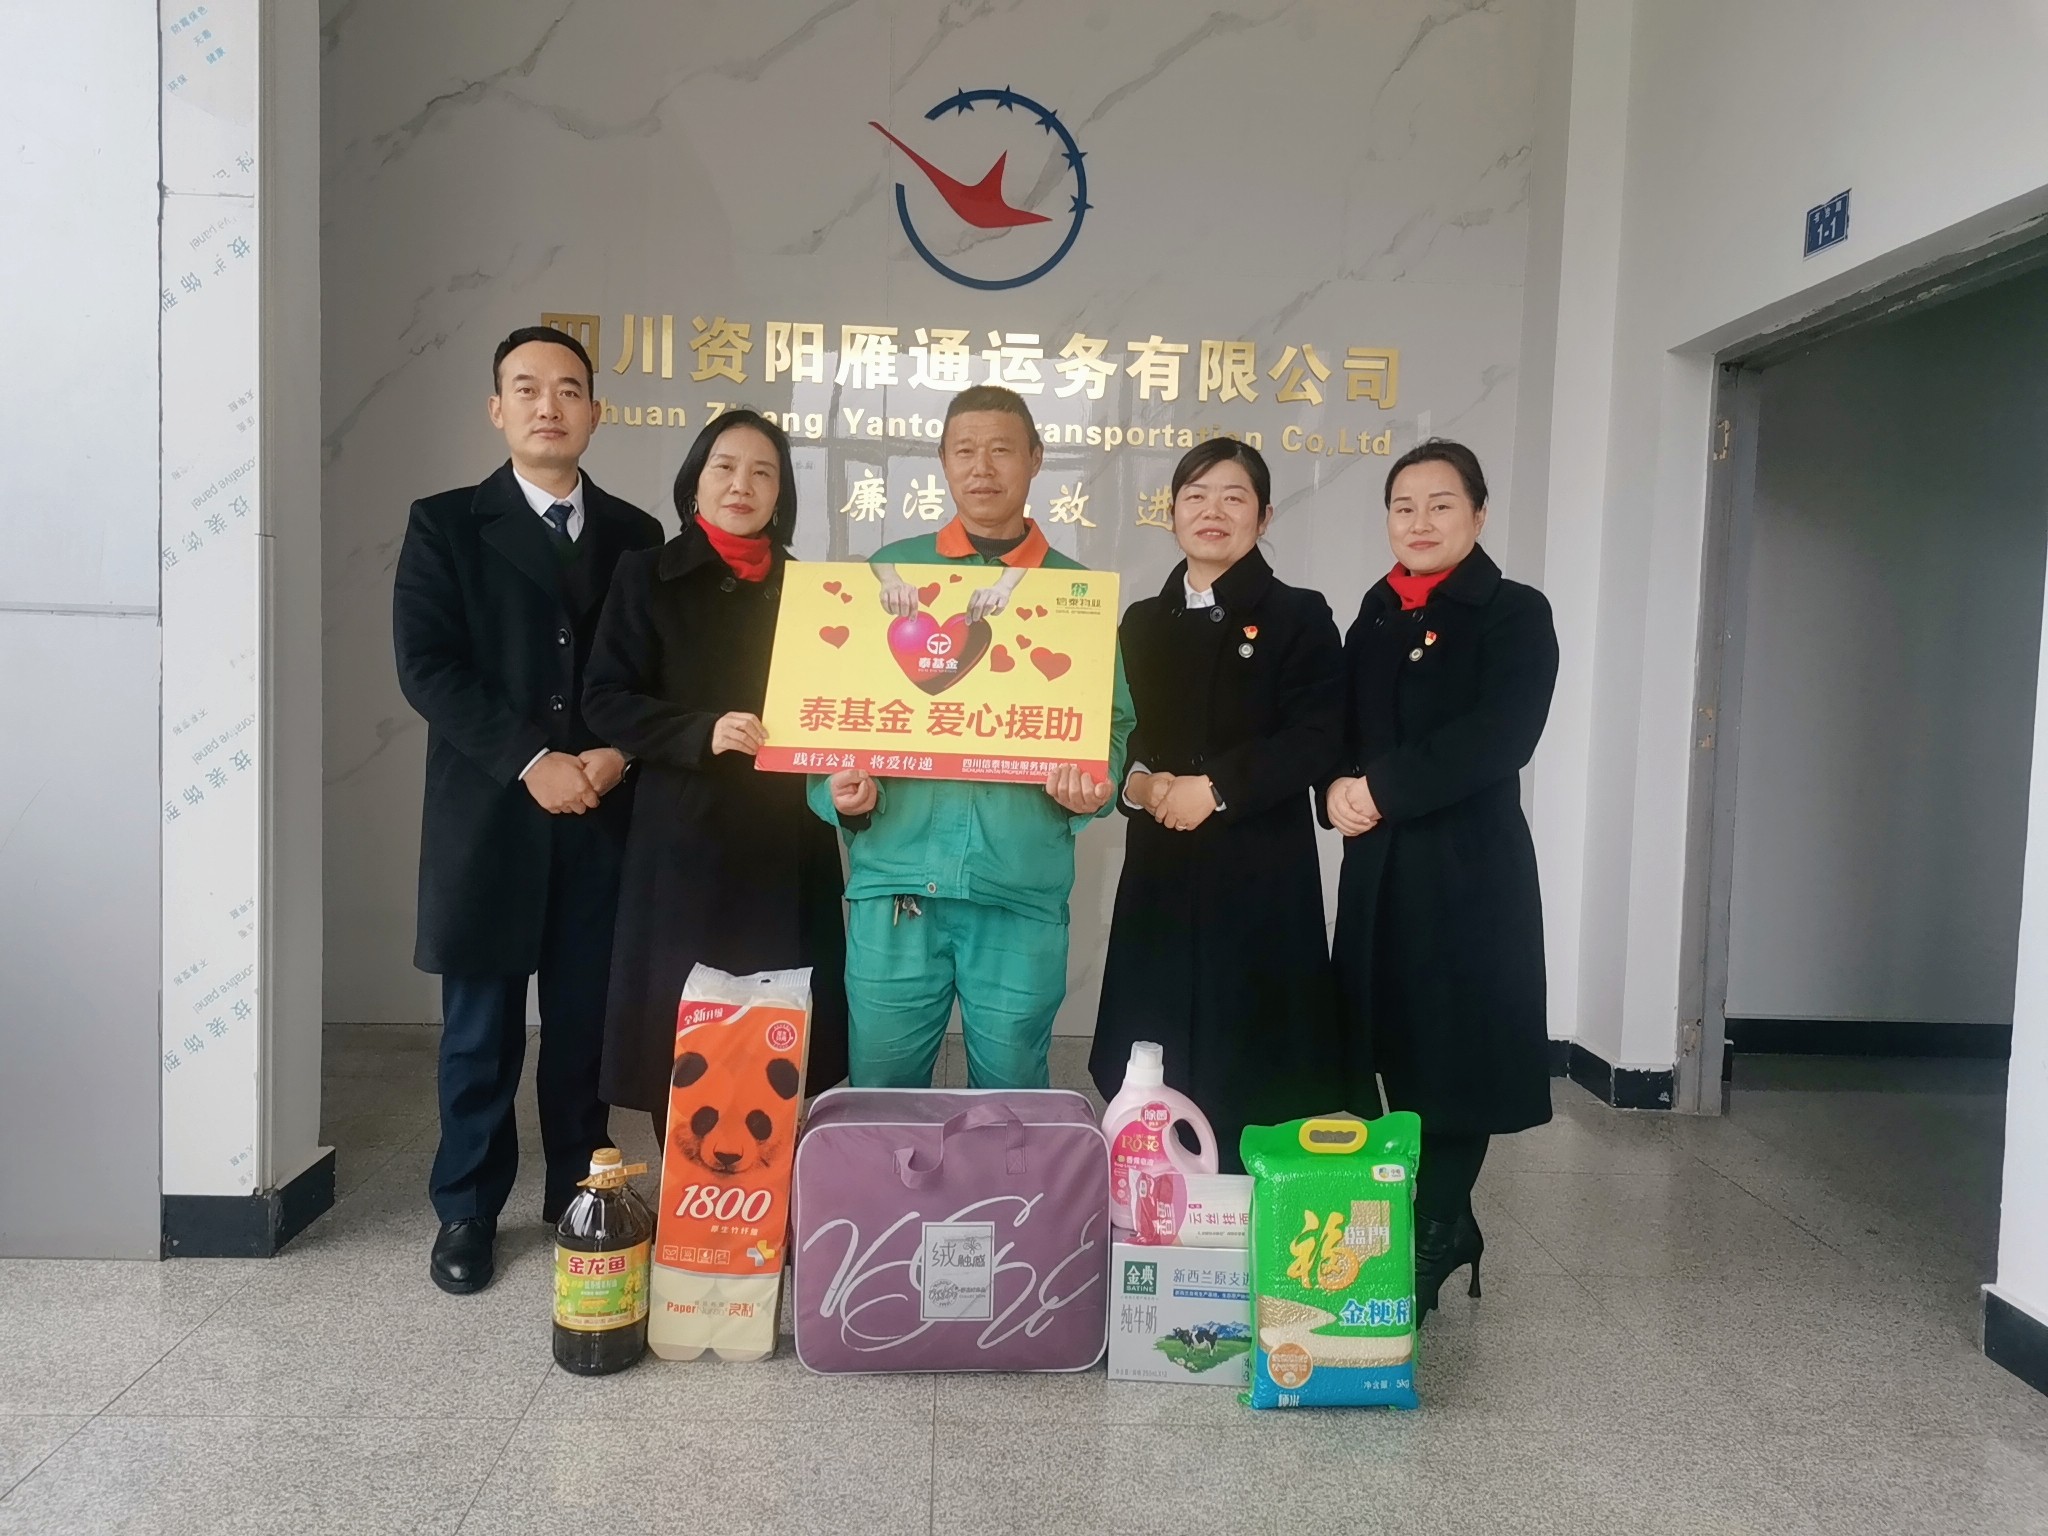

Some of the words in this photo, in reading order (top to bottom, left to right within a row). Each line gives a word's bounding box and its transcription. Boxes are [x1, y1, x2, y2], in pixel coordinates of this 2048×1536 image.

[1817, 217, 1836, 246] 1-1
[541, 312, 1399, 410] 四川资阳雁通运务有限公司
[843, 407, 943, 439] Yanto
[839, 470, 946, 523] 廉洁
[918, 657, 959, 670] 泰基金
[799, 696, 915, 734] 泰基金
[926, 700, 1083, 742] 爱心援助
[792, 751, 857, 769] 践行公益
[869, 754, 933, 771] 将爱传递
[675, 1184, 772, 1223] 1800
[1189, 1212, 1249, 1226] 云丝挂面
[568, 1255, 627, 1276] 金龙鱼
[1126, 1264, 1155, 1286] 金典
[1126, 1285, 1154, 1293] SATINE
[667, 1302, 696, 1314] Paper
[1120, 1303, 1158, 1335] 纯牛奶
